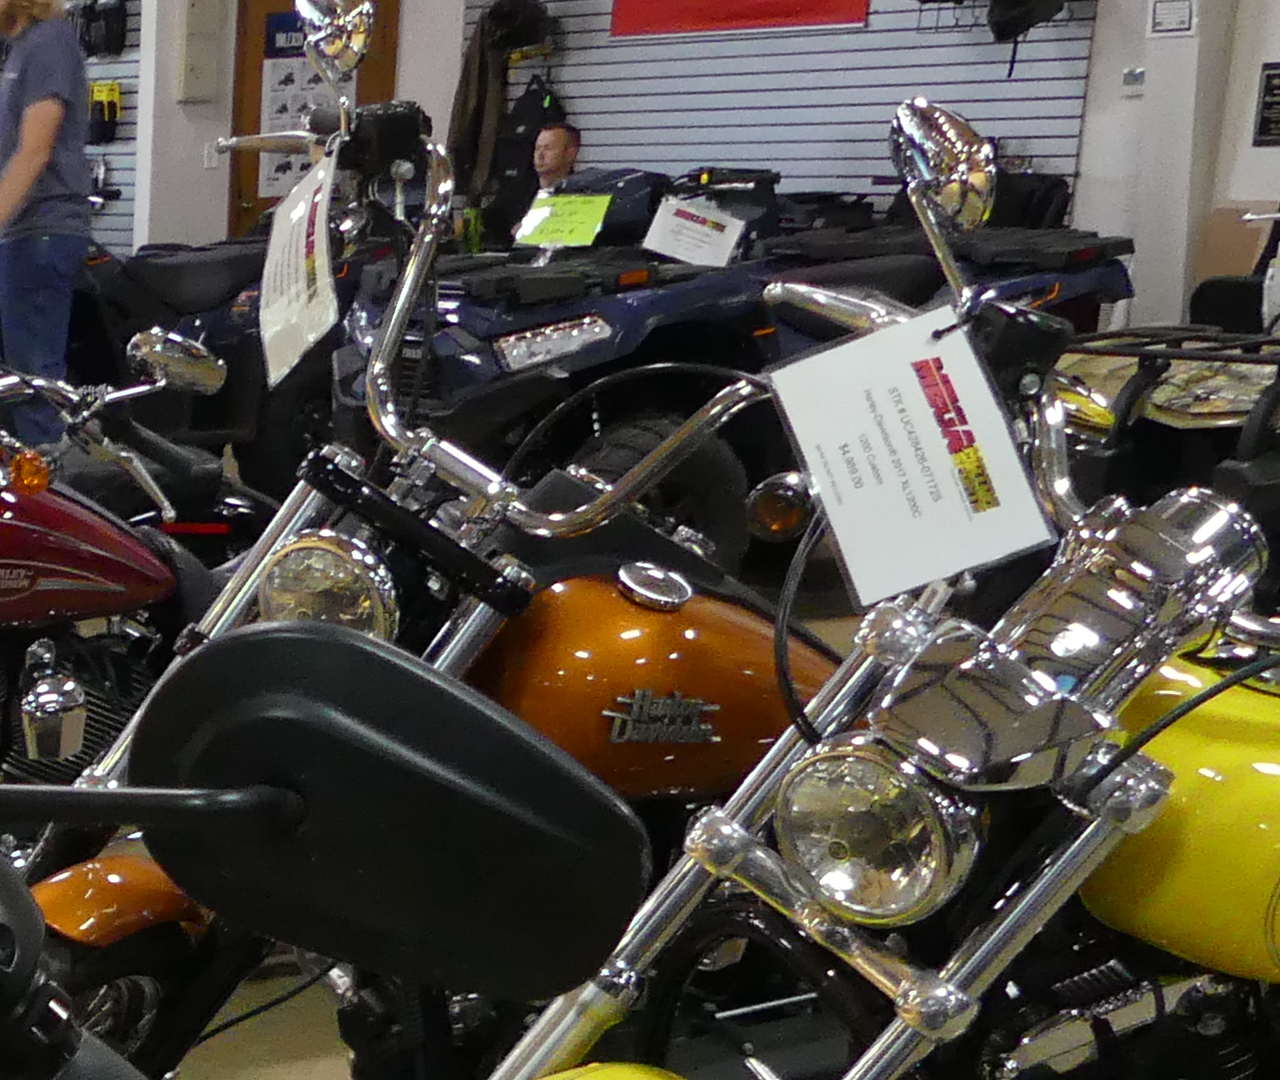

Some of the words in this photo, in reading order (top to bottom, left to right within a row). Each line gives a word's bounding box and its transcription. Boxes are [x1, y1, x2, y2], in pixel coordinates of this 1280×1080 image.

[888, 387, 904, 407] STK
[911, 356, 976, 454] MEGA
[859, 434, 872, 454] 1200
[866, 455, 885, 486] Custom
[620, 689, 715, 723] Harley
